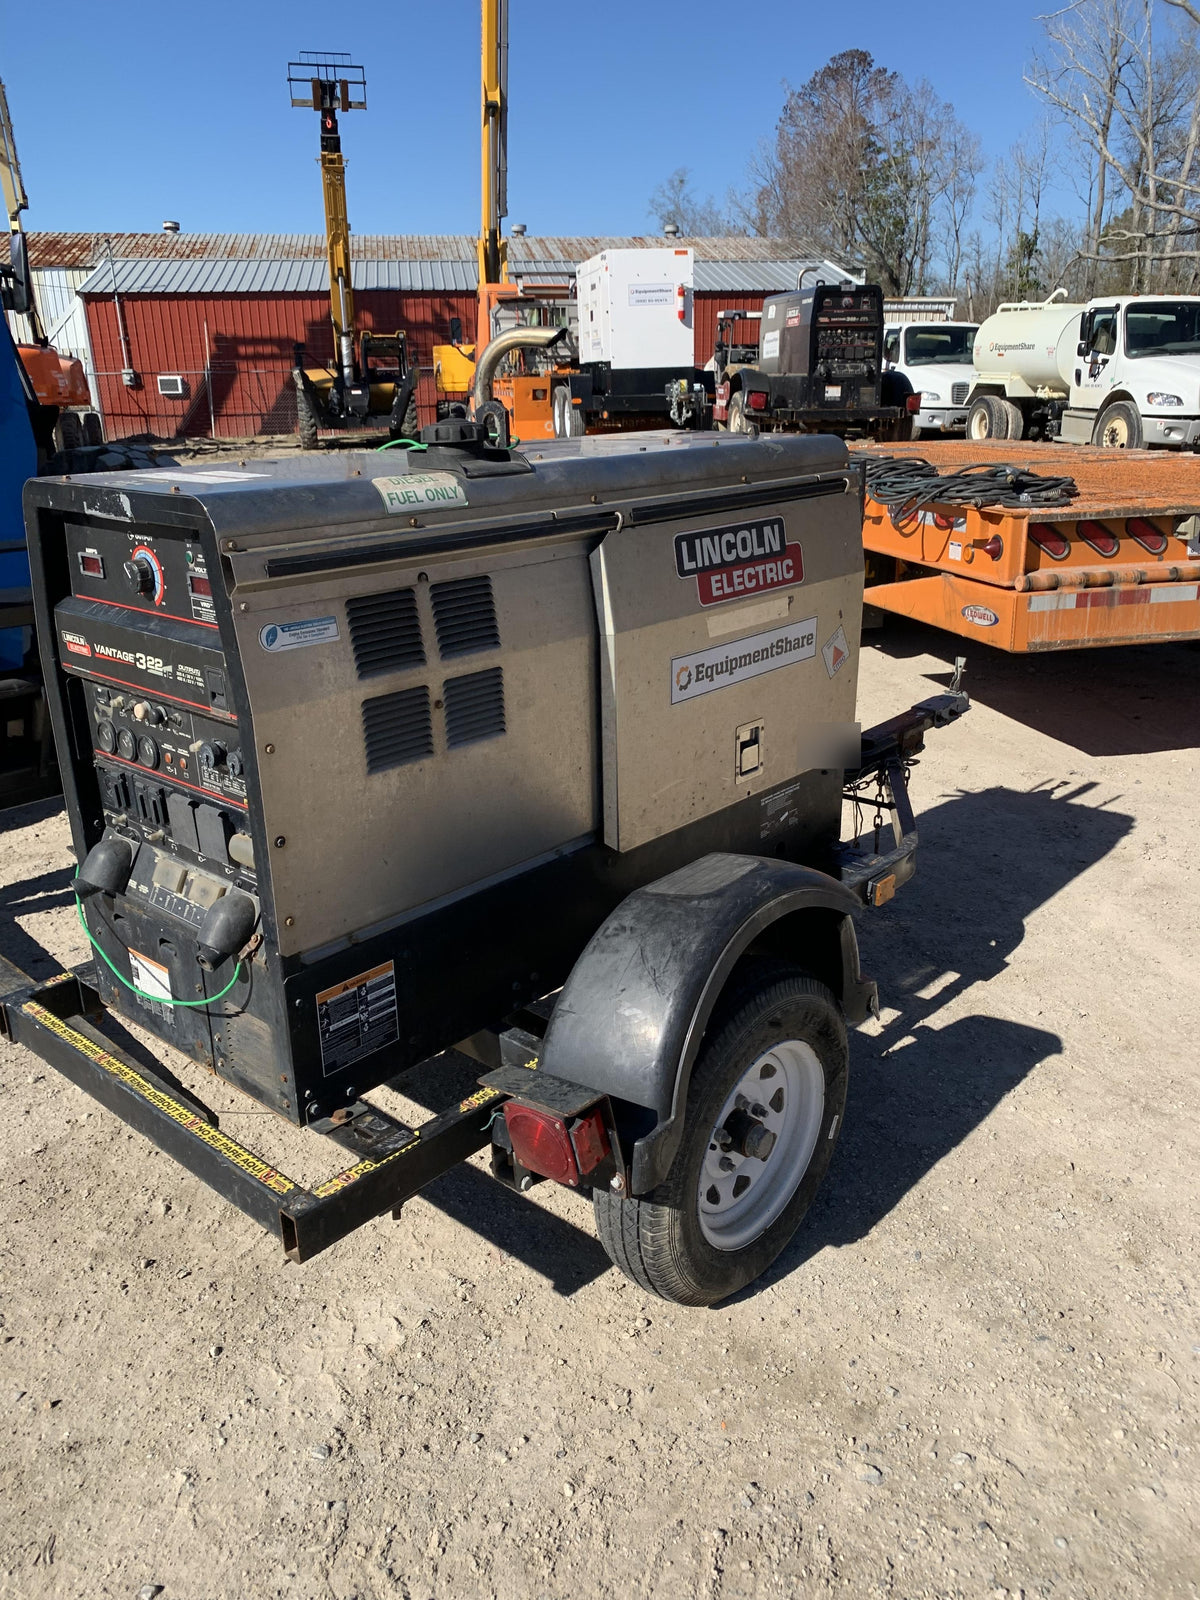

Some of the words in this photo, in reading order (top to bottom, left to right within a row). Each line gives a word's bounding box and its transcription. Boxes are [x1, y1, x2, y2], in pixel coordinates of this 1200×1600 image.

[994, 343, 1036, 352] EquipmentShare
[388, 474, 439, 485] DIESEL
[387, 490, 424, 506] FUEL
[425, 486, 458, 500] ONLY
[681, 524, 781, 570] LINCOLN
[711, 558, 794, 597] ELECTRIC
[966, 608, 993, 622] LEDWELL
[63, 633, 85, 645] LINCOLN
[94, 643, 135, 663] VANTAGE
[136, 652, 163, 671] 322
[695, 633, 814, 682] EquipmentShare
[49, 1020, 65, 1030] NOT
[60, 1029, 83, 1044] STAND
[81, 1042, 101, 1056] HERE
[104, 1059, 116, 1068] NE
[114, 1065, 130, 1077] PAS
[128, 1075, 149, 1092] TENEZ
[148, 1091, 180, 1114] DEBOUT
[178, 1109, 190, 1121] ICI
[196, 1125, 211, 1136] NO
[208, 1134, 222, 1144] SE
[219, 1140, 244, 1159] PARE
[354, 1163, 373, 1175] DO
